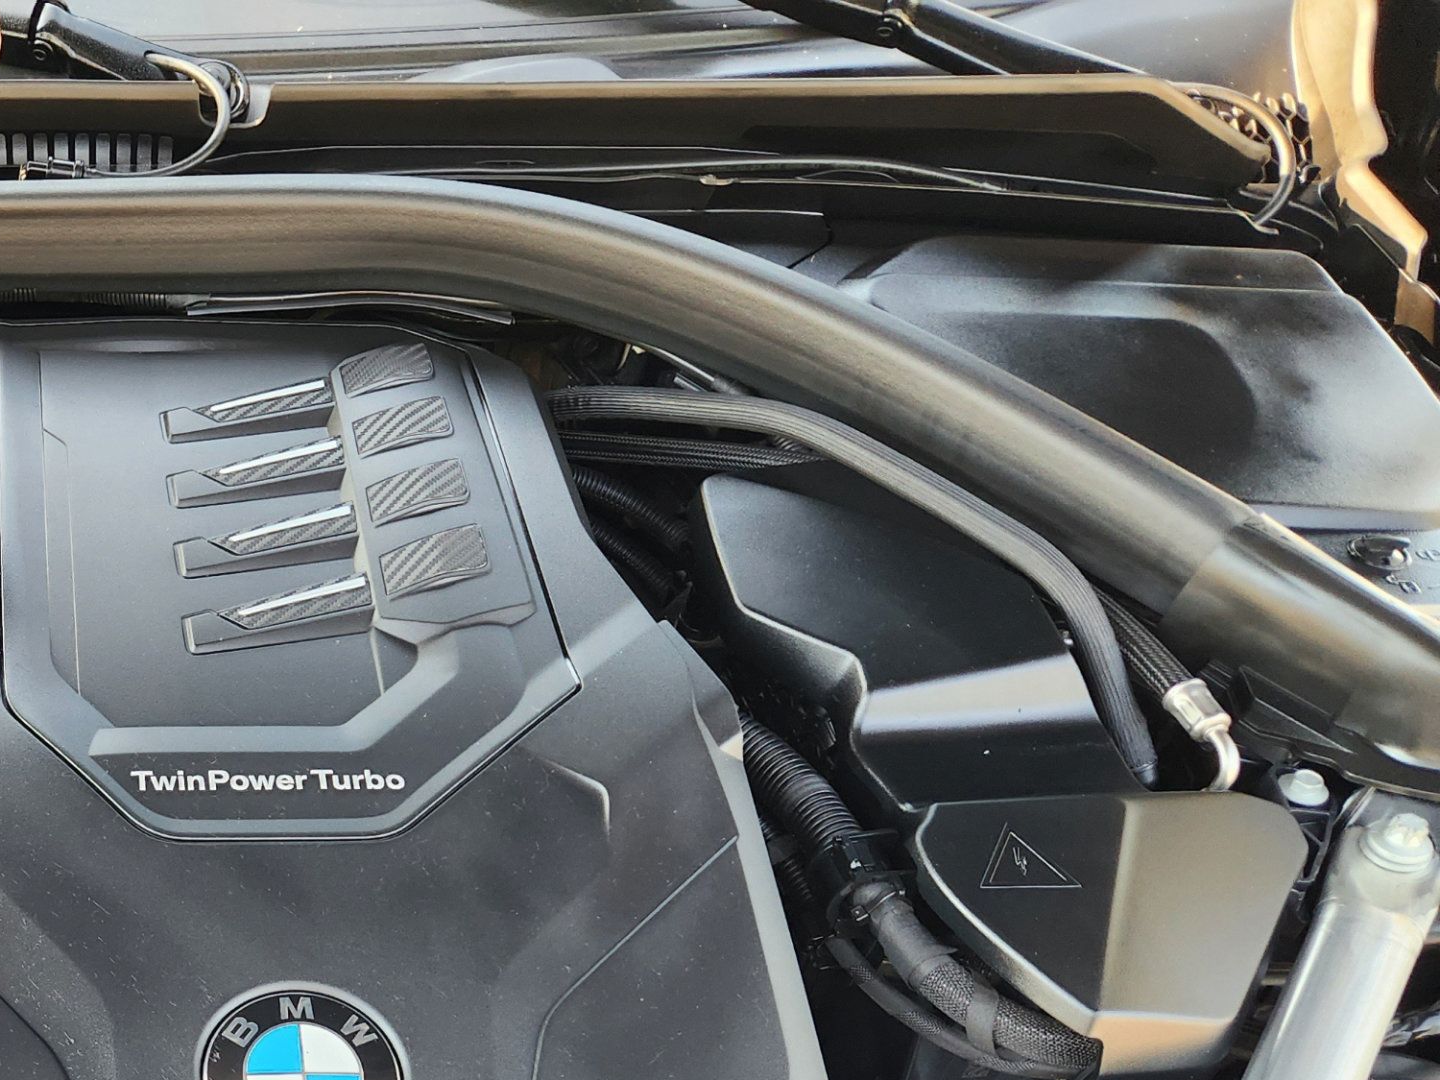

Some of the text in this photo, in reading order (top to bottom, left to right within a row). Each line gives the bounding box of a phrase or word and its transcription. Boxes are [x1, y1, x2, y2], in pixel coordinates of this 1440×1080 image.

[130, 769, 405, 791] TwinPower Turbo
[222, 997, 378, 1048] BMW
